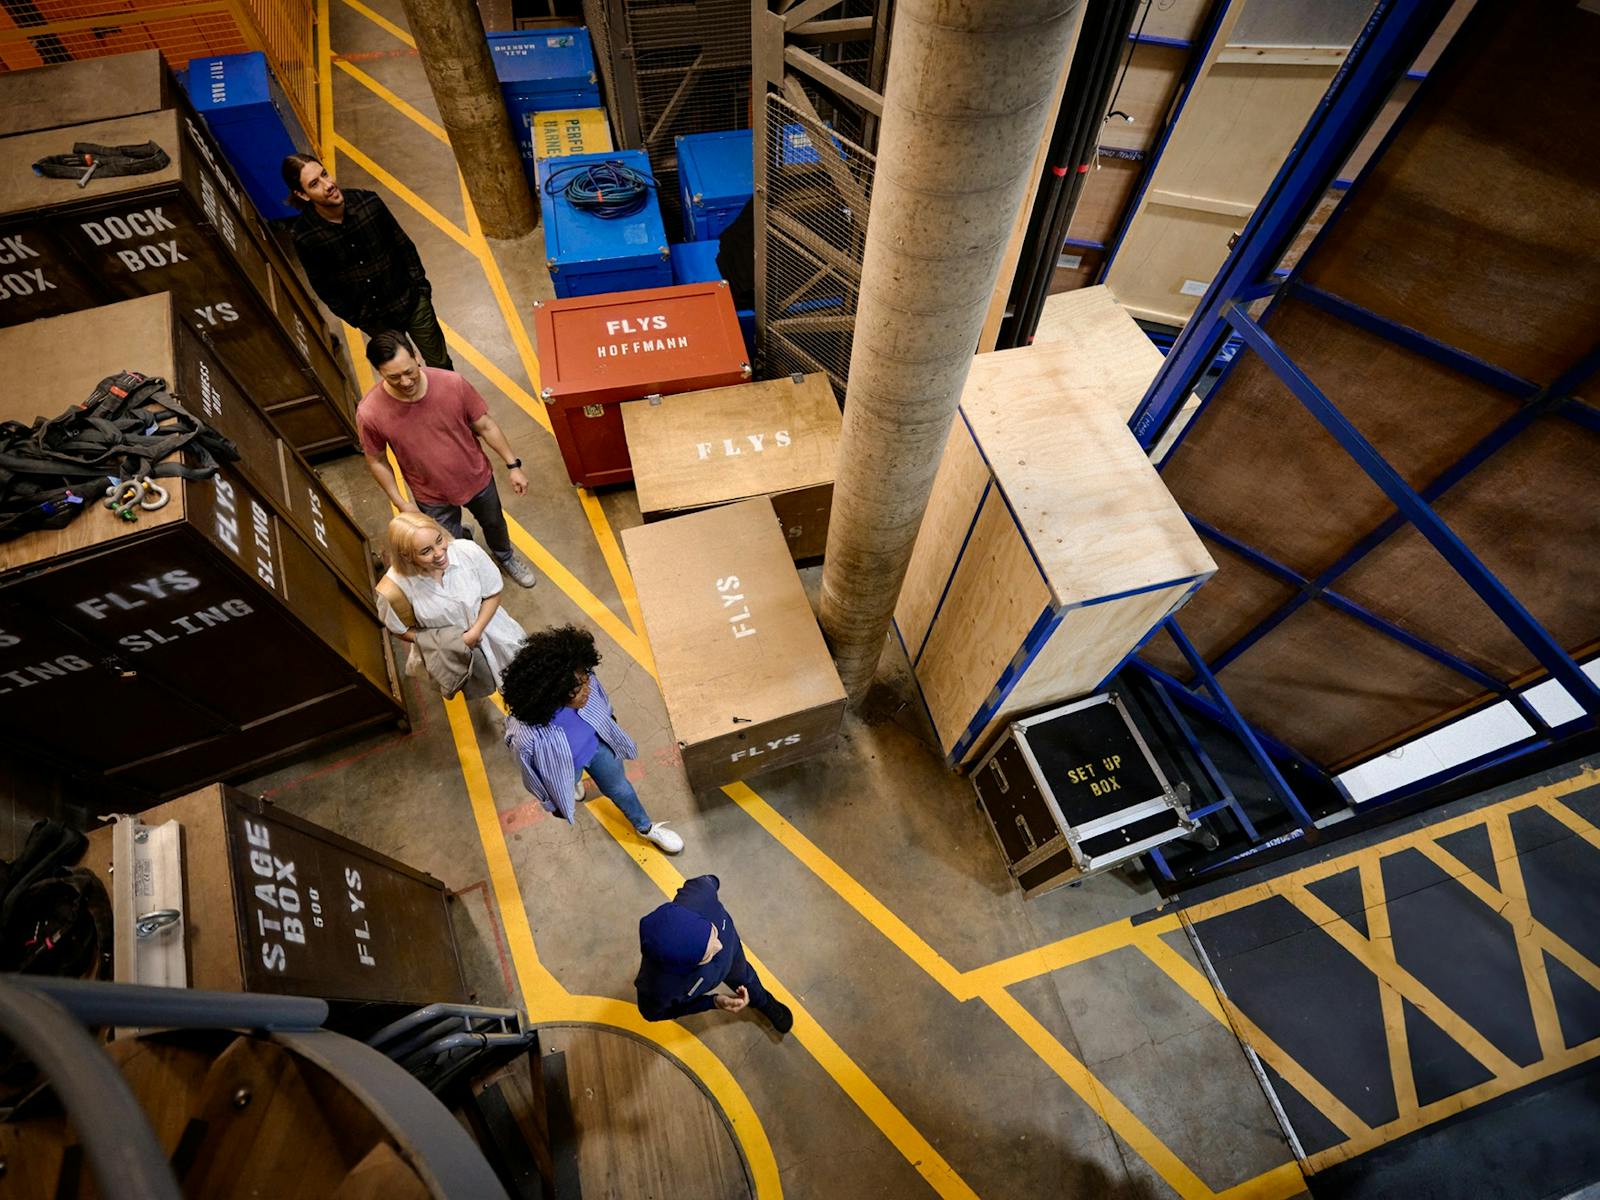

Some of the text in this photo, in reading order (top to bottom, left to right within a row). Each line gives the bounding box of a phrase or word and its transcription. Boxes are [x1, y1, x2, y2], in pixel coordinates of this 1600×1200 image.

[210, 60, 227, 104] TRIP BAGS
[565, 119, 584, 152] PERFO
[80, 207, 176, 246] DOCK
[117, 240, 189, 272] BOX
[194, 302, 239, 328] YS
[606, 315, 668, 336] FLYS
[597, 336, 688, 358] HOFFMANN
[199, 360, 212, 418] HARNESS
[694, 430, 791, 460] FLYS
[214, 472, 239, 555] FLYS
[308, 487, 328, 549] FLYS
[251, 500, 275, 590] SLING
[74, 568, 201, 620] FLYS
[715, 574, 756, 639] FLYS
[118, 598, 255, 652] SLING
[730, 733, 802, 763] FLYS
[1067, 754, 1122, 784] SET UP
[1089, 775, 1121, 797] BOX
[244, 820, 286, 972] STAGE
[273, 855, 306, 944] BOX
[344, 867, 376, 967] FLYS
